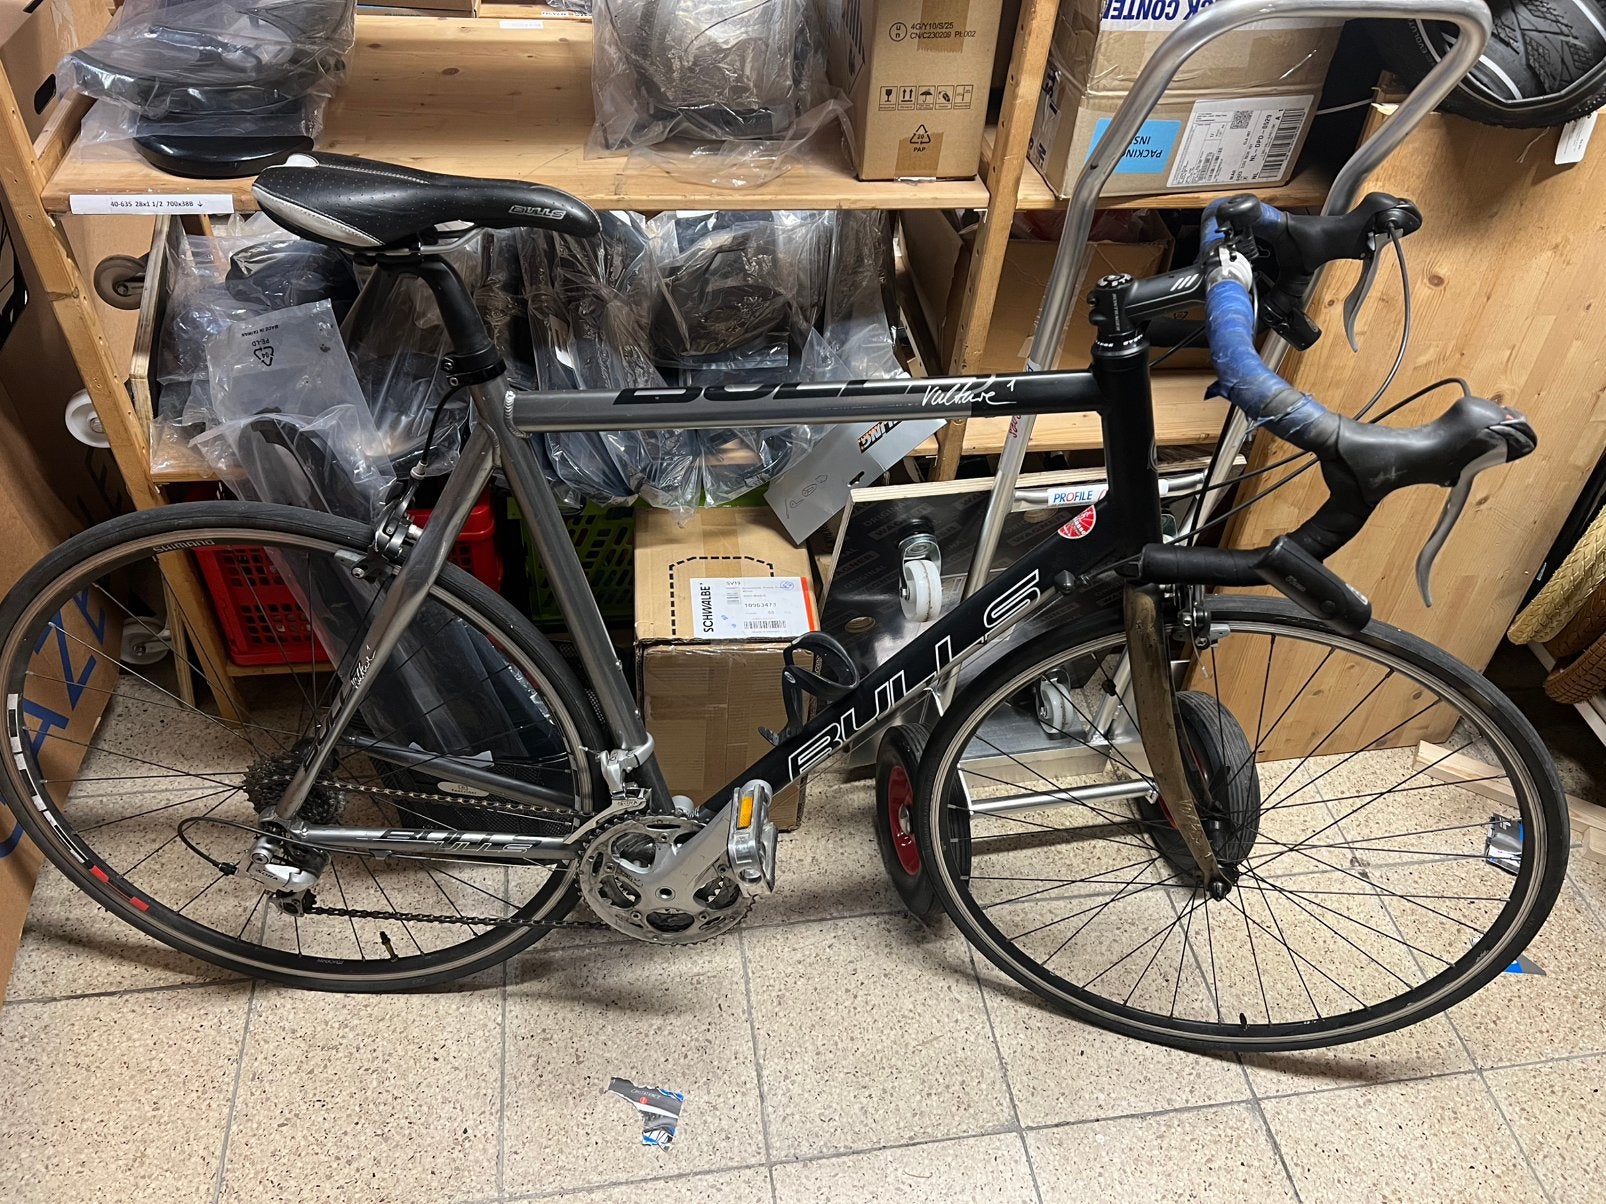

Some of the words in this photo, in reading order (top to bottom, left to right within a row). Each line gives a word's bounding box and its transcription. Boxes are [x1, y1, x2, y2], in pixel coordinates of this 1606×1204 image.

[1133, 135, 1151, 145] INS
[1125, 149, 1163, 158] PACKIN
[152, 200, 163, 208] 1/2
[508, 204, 567, 220] BULLS
[241, 329, 259, 337] TAIWAN
[265, 324, 279, 332] MADE
[251, 337, 270, 347] PE-LD
[921, 381, 1017, 407] Vulture
[1053, 490, 1093, 503] PROFILE
[700, 586, 714, 633] SCHWALBE
[788, 569, 1041, 783] BULLS
